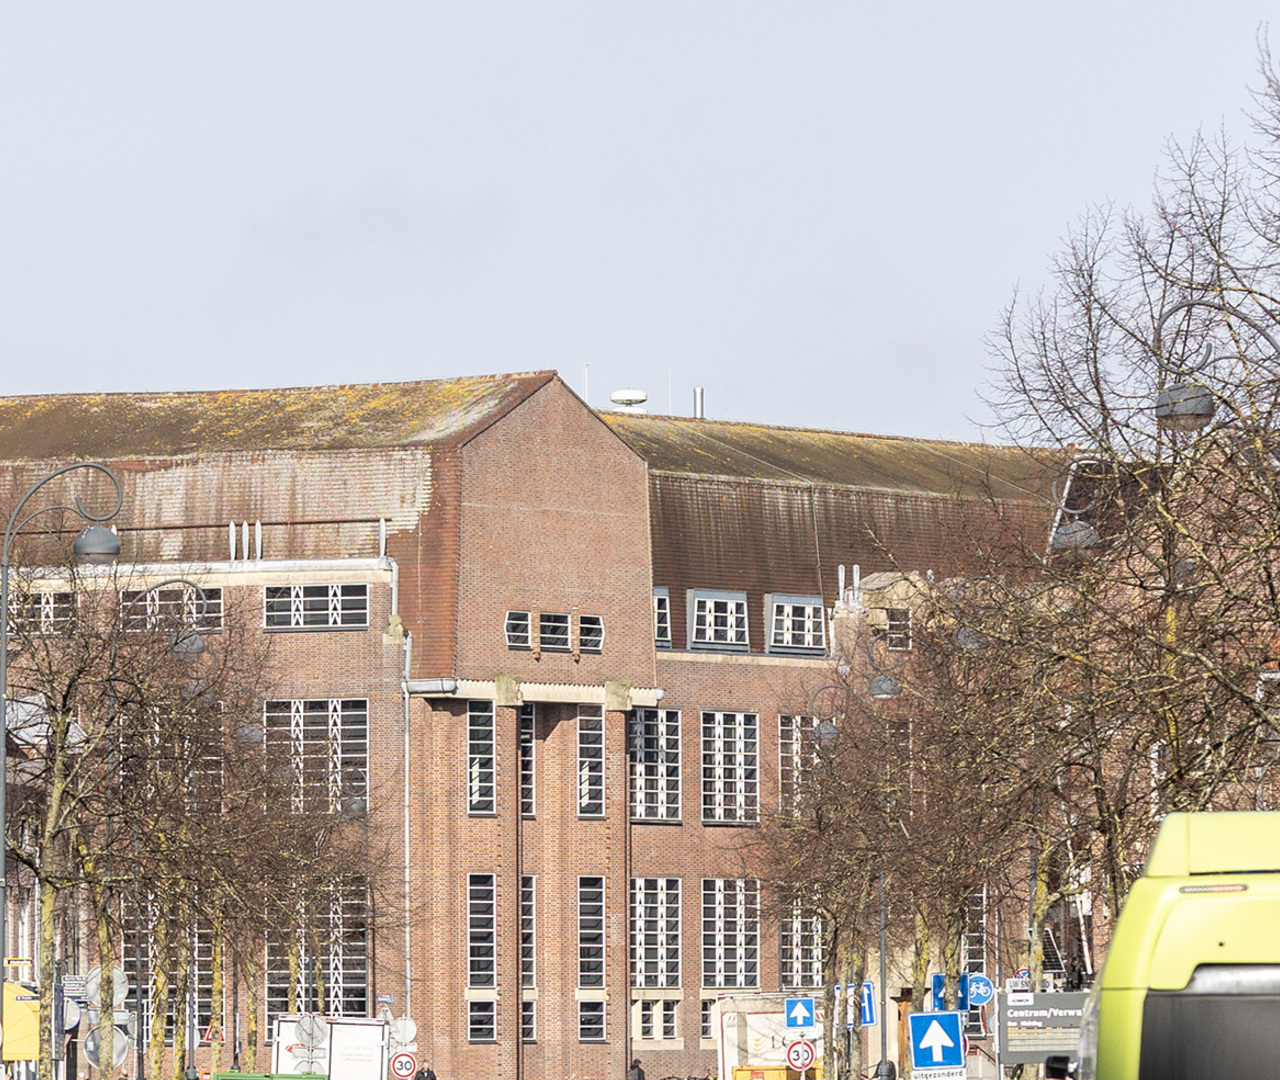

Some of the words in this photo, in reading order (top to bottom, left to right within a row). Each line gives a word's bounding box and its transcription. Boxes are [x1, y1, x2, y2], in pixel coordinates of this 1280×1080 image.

[1007, 1008, 1085, 1018] Centrum/Verwu
[792, 1049, 810, 1062] 30
[396, 1061, 413, 1071] 30
[913, 1070, 964, 1080] uitgezonderd
